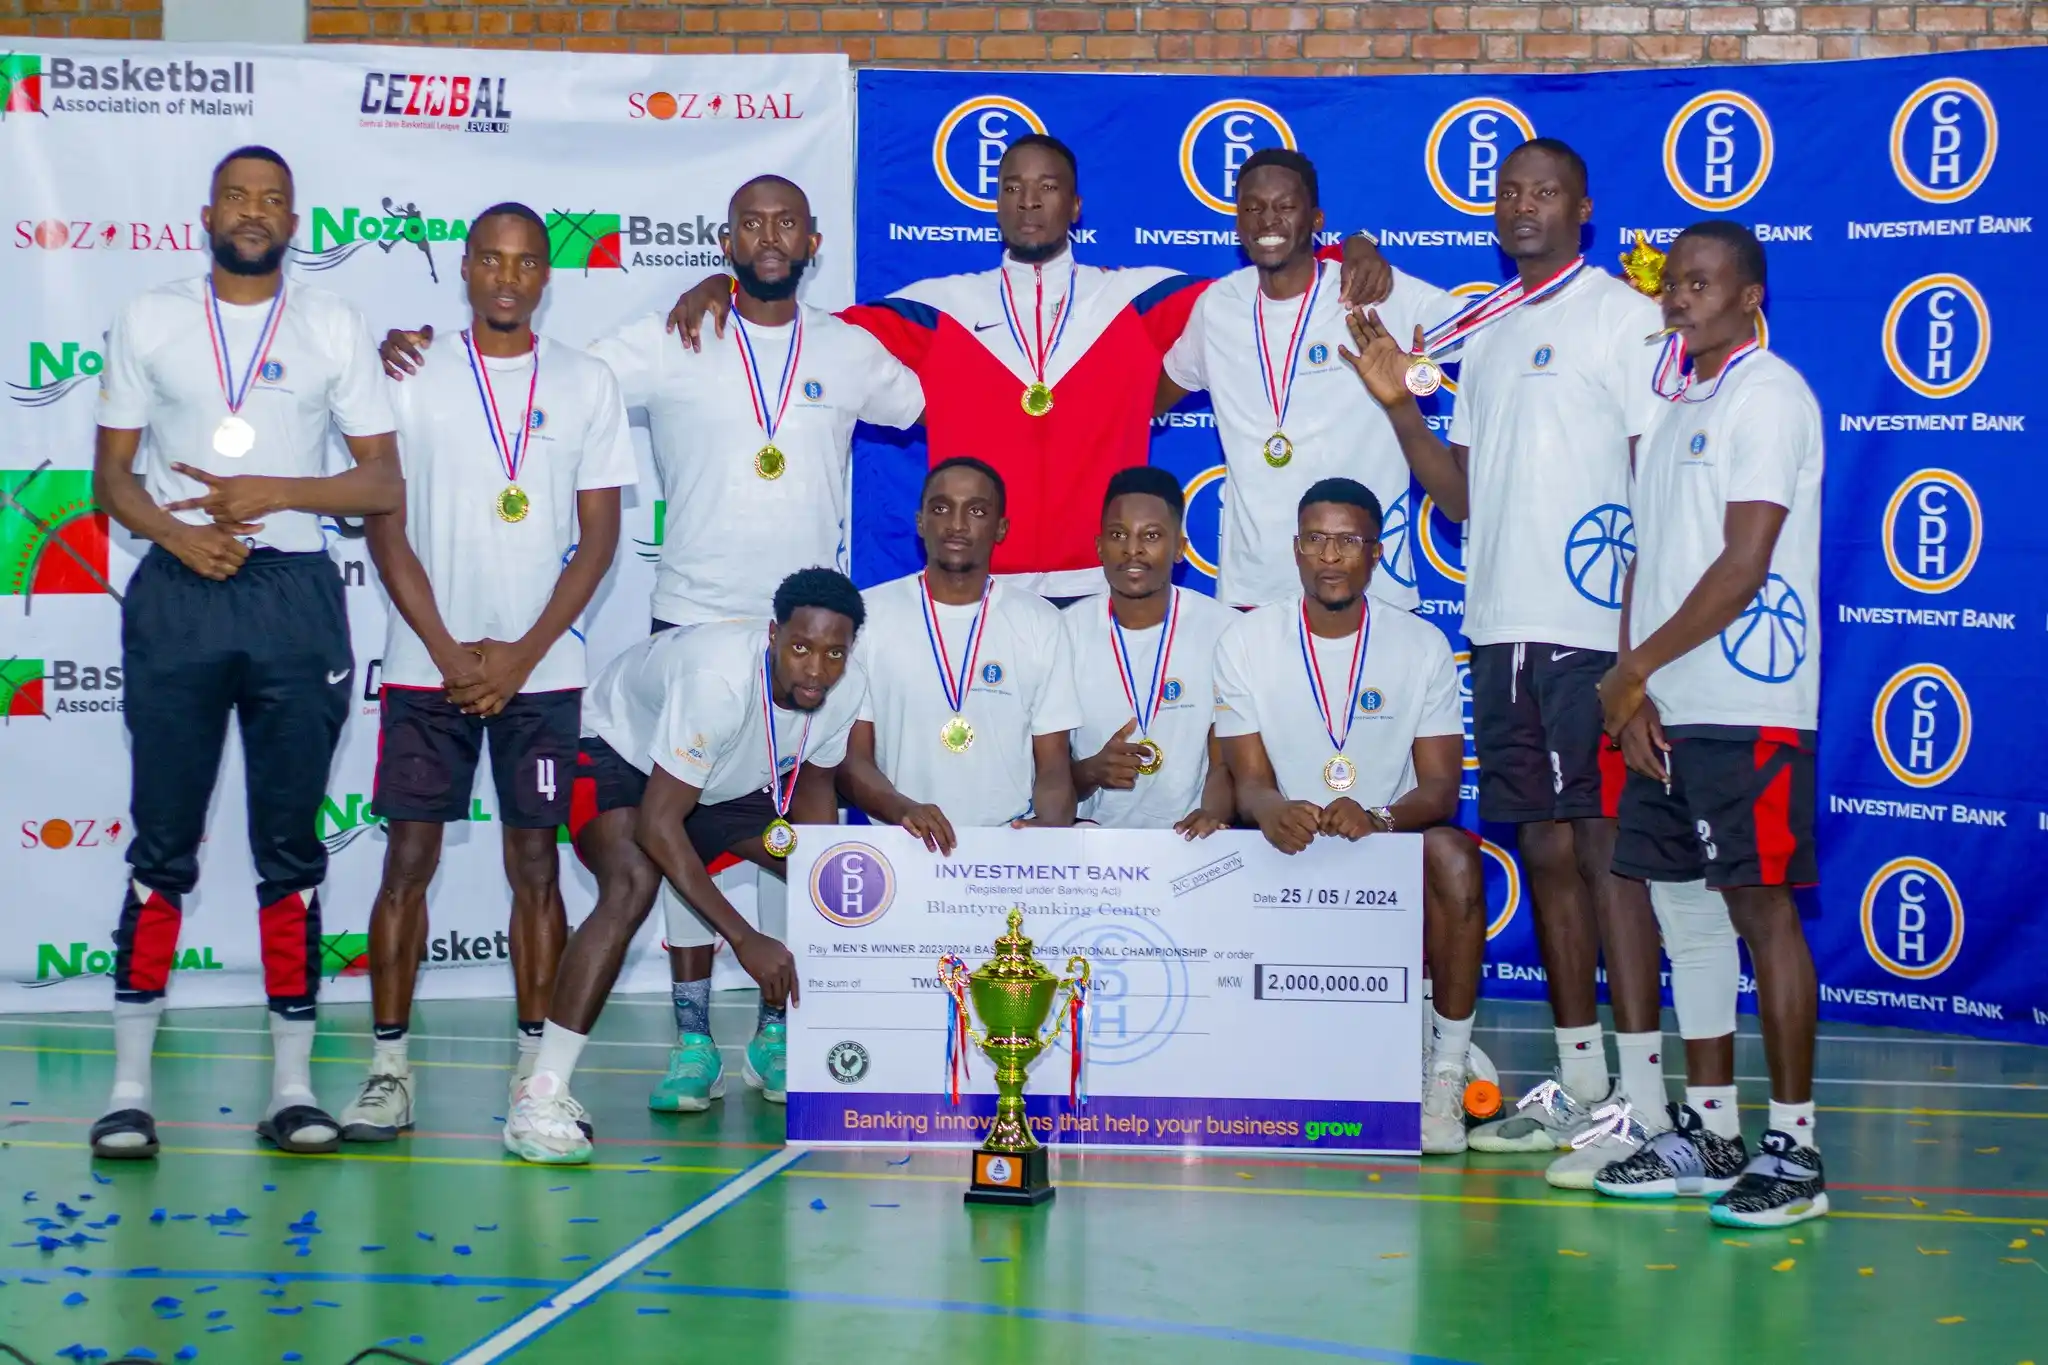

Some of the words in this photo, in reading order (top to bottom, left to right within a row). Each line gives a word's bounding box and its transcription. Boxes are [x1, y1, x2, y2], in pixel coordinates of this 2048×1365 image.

[50, 58, 254, 94] Basketball
[52, 96, 161, 114] Association
[167, 97, 189, 115] of
[191, 98, 254, 117] Malawi
[1705, 107, 1735, 193] CDH
[1929, 95, 1961, 184] CDH
[312, 207, 469, 254] NOZOBA
[889, 223, 1003, 242] INVESTME
[1134, 227, 1242, 246] INVESTME
[1380, 229, 1500, 247] INVESTMEN
[1619, 226, 1682, 245] INVES
[1755, 223, 1813, 242] BANK
[1848, 218, 1975, 240] INVESTMENT
[1978, 215, 2033, 234] BANK
[1927, 290, 1955, 379] CDH
[1840, 413, 1968, 431] INVESTMENT
[1971, 412, 2026, 431] BANK
[1918, 485, 1949, 574] CDH
[1838, 605, 1960, 628] INVESTMENT
[1962, 609, 2016, 629] BANK
[55, 698, 125, 714] Associa
[1909, 680, 1939, 769] CDH
[536, 758, 557, 802] 4
[1830, 795, 1948, 822] INVESTMENT
[1951, 804, 2007, 827] BANK
[841, 854, 864, 914] CDH
[935, 864, 1080, 881] INVESTMENT
[1087, 865, 1151, 881] BANK
[1172, 879, 1190, 893] A/C
[1191, 864, 1222, 885] payee
[1222, 854, 1245, 873] only
[965, 883, 1023, 896] (Registered
[1026, 885, 1055, 896] under
[1058, 885, 1098, 898] Banking
[1099, 886, 1122, 898] Act)
[1253, 892, 1278, 904] Date
[1280, 888, 1302, 904] 25
[1317, 889, 1339, 905] 05
[1355, 890, 1398, 906] 2024
[927, 900, 1007, 917] Blantyre
[1013, 902, 1092, 918] Banking
[1098, 902, 1161, 917] Centre
[1898, 873, 1926, 961] CDH
[809, 944, 828, 956] Pay
[833, 943, 868, 954] MEN'S
[872, 944, 916, 954] WINNER
[919, 944, 971, 954] 2023/2024
[974, 945, 997, 955] BAS
[1062, 946, 1119, 956] NATIONAL
[1121, 946, 1208, 958] CHAMPIONSHIP
[1213, 951, 1225, 961] or
[1226, 949, 1254, 961] order
[809, 978, 825, 988] the
[827, 980, 848, 988] sum
[851, 978, 861, 988] of
[1217, 975, 1244, 989] MKW
[1268, 973, 1389, 993] 2,000,000.00
[1497, 963, 1547, 981] BAN
[1820, 984, 1948, 1012] INVESTMENT
[1952, 995, 2004, 1020] BANK
[843, 1109, 928, 1133] Banking
[1059, 1112, 1101, 1132] that
[1105, 1114, 1150, 1136] help
[1155, 1118, 1202, 1138] your
[1206, 1115, 1300, 1136] business
[1304, 1119, 1363, 1141] grow
